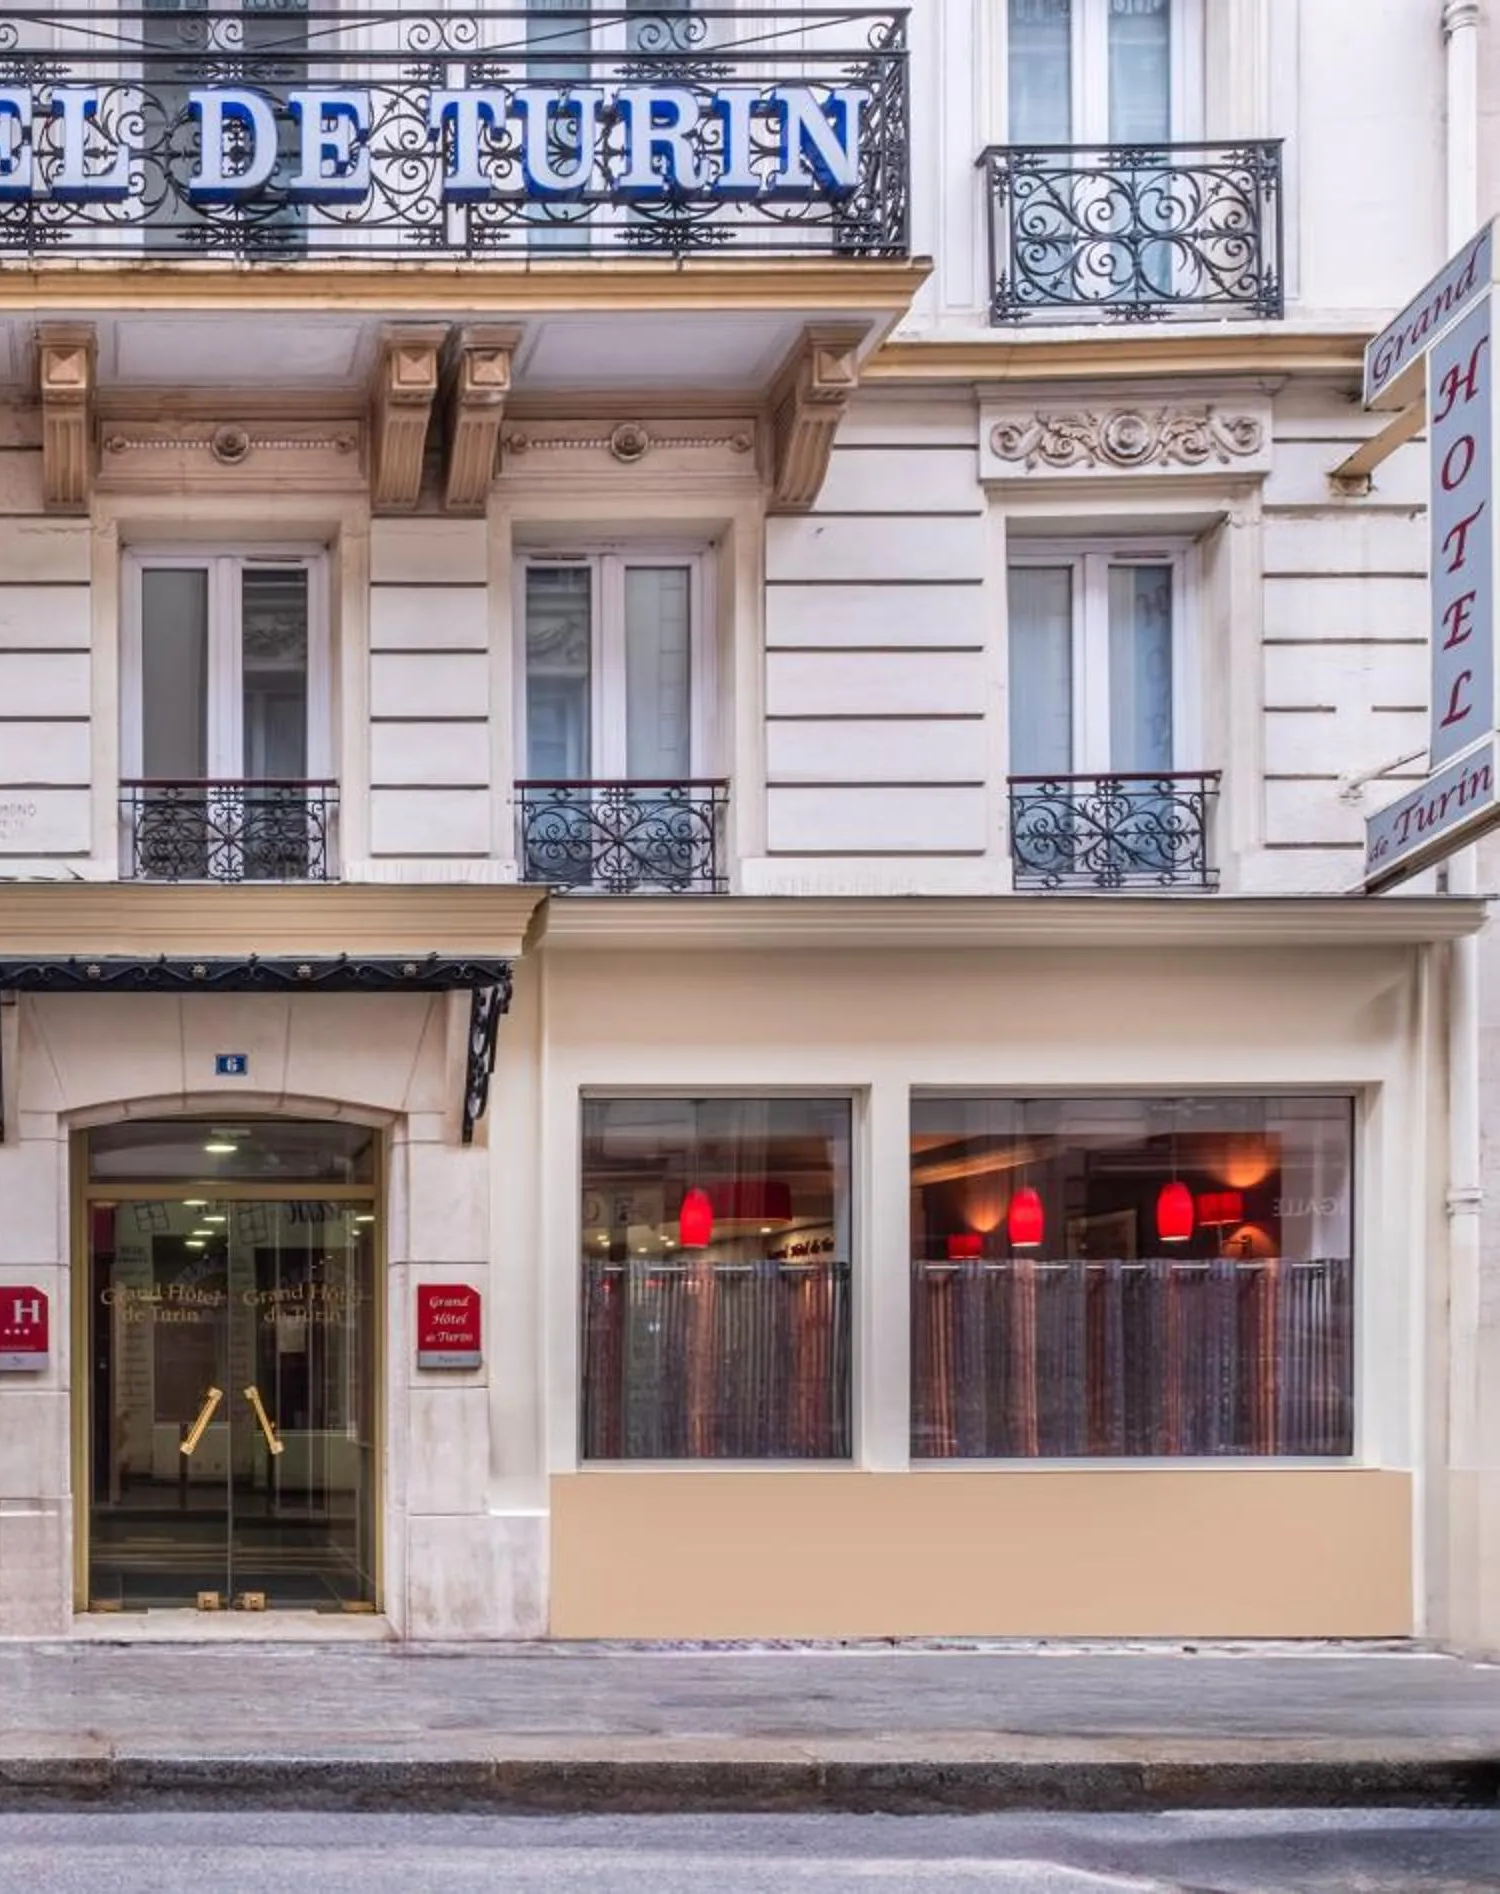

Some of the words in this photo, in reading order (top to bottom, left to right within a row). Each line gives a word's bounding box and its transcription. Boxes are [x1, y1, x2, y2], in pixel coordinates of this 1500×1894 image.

[188, 87, 375, 200] DE
[429, 87, 870, 198] TURIN
[1371, 234, 1488, 390] Grand
[1433, 335, 1490, 729] HOTEL
[1367, 834, 1390, 863] de
[1393, 763, 1494, 845] Turin
[226, 1055, 238, 1073] 6
[12, 1299, 41, 1324] H
